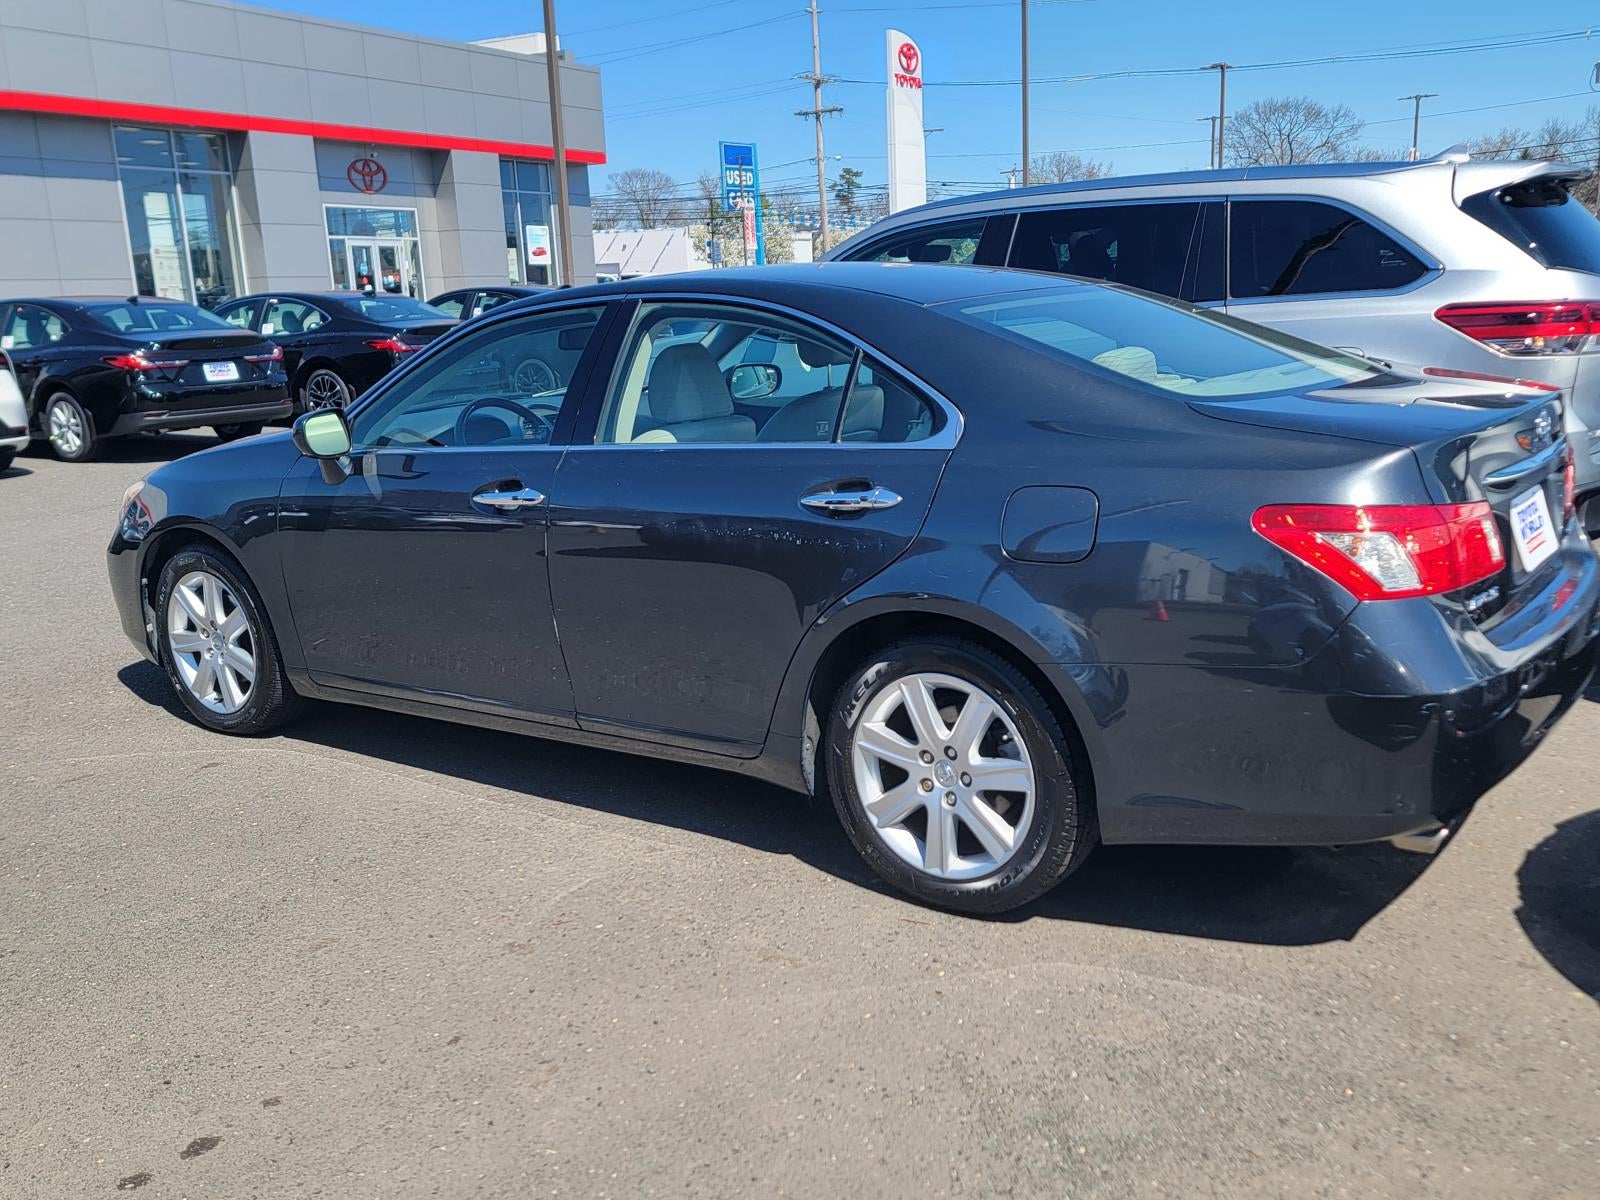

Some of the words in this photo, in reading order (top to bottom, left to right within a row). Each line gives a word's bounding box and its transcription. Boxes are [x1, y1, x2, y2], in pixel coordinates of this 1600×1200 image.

[895, 73, 922, 88] TOYOTA
[726, 169, 754, 186] USED
[1517, 501, 1539, 523] TOYOTA
